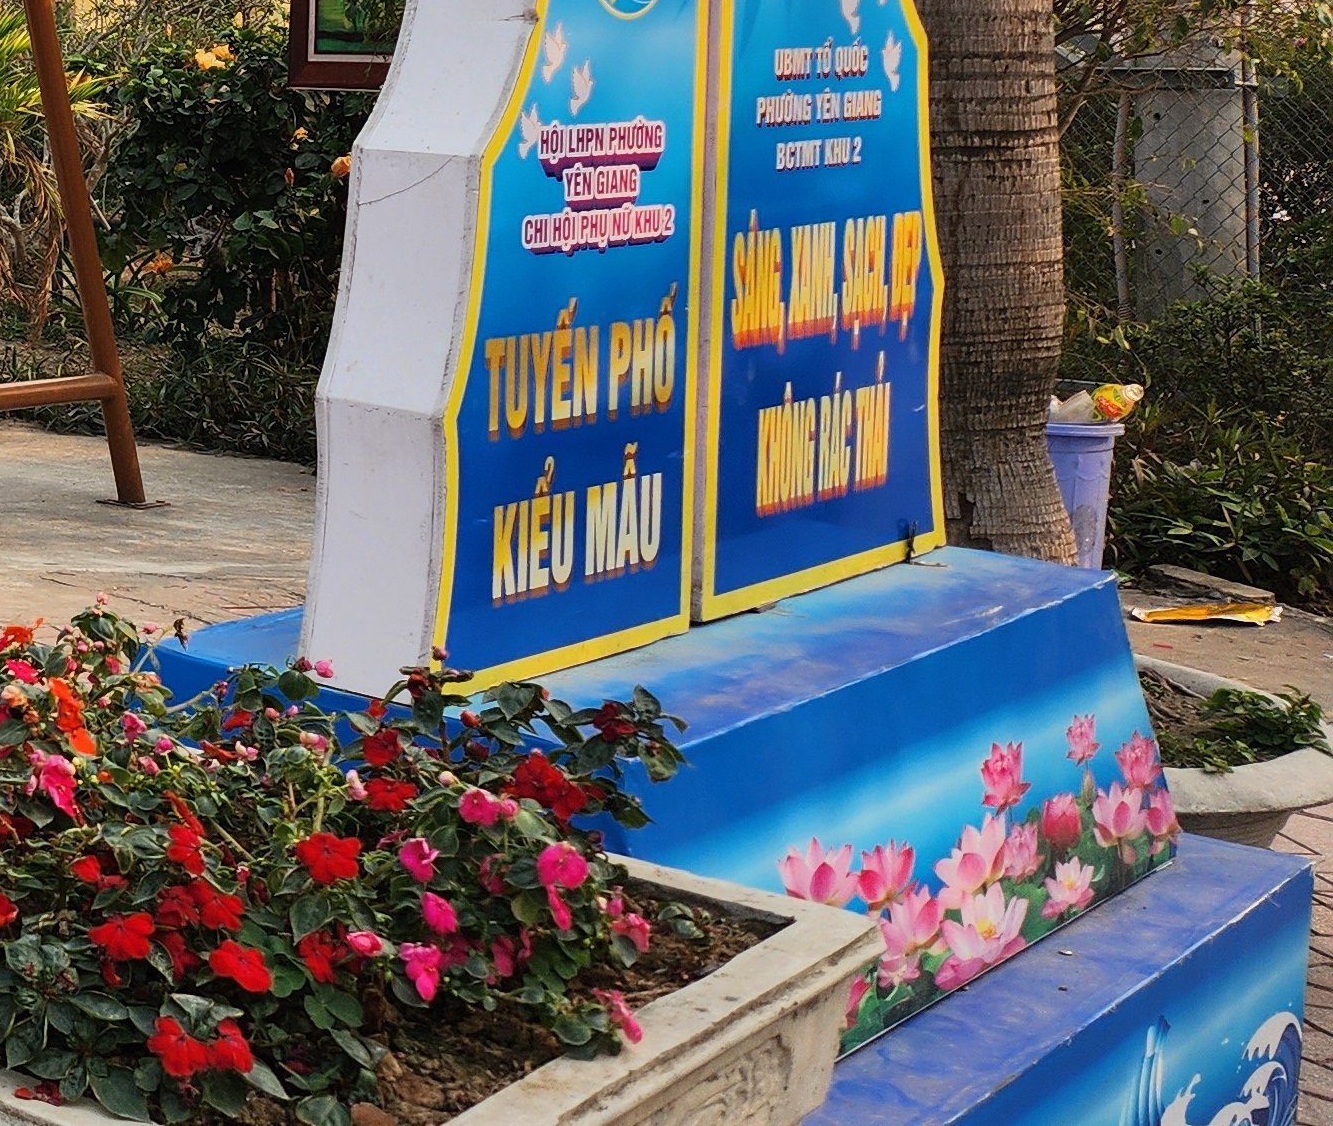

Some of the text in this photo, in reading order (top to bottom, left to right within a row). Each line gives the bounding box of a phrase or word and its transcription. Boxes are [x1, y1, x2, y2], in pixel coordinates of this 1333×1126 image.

[774, 36, 869, 79] UBMT TỔ QUỐC
[756, 87, 883, 125] PHƯỜNG YÊN GIANG
[539, 117, 664, 161] HỘI LHPN PHƯỜNG
[776, 136, 863, 171] BCTMT KHU 2
[564, 165, 639, 199] YÊN GIANG
[523, 205, 673, 248] CHI HỘI PHỤ NỮ KHU 2
[730, 209, 923, 348] SÁNG, XANH, SẠCH, ĐẸP
[485, 282, 678, 436] TUYẾN PHỐ
[756, 381, 817, 512] KHÔNG
[818, 371, 853, 494] RÁC
[491, 441, 663, 602] KIỂU MẪU
